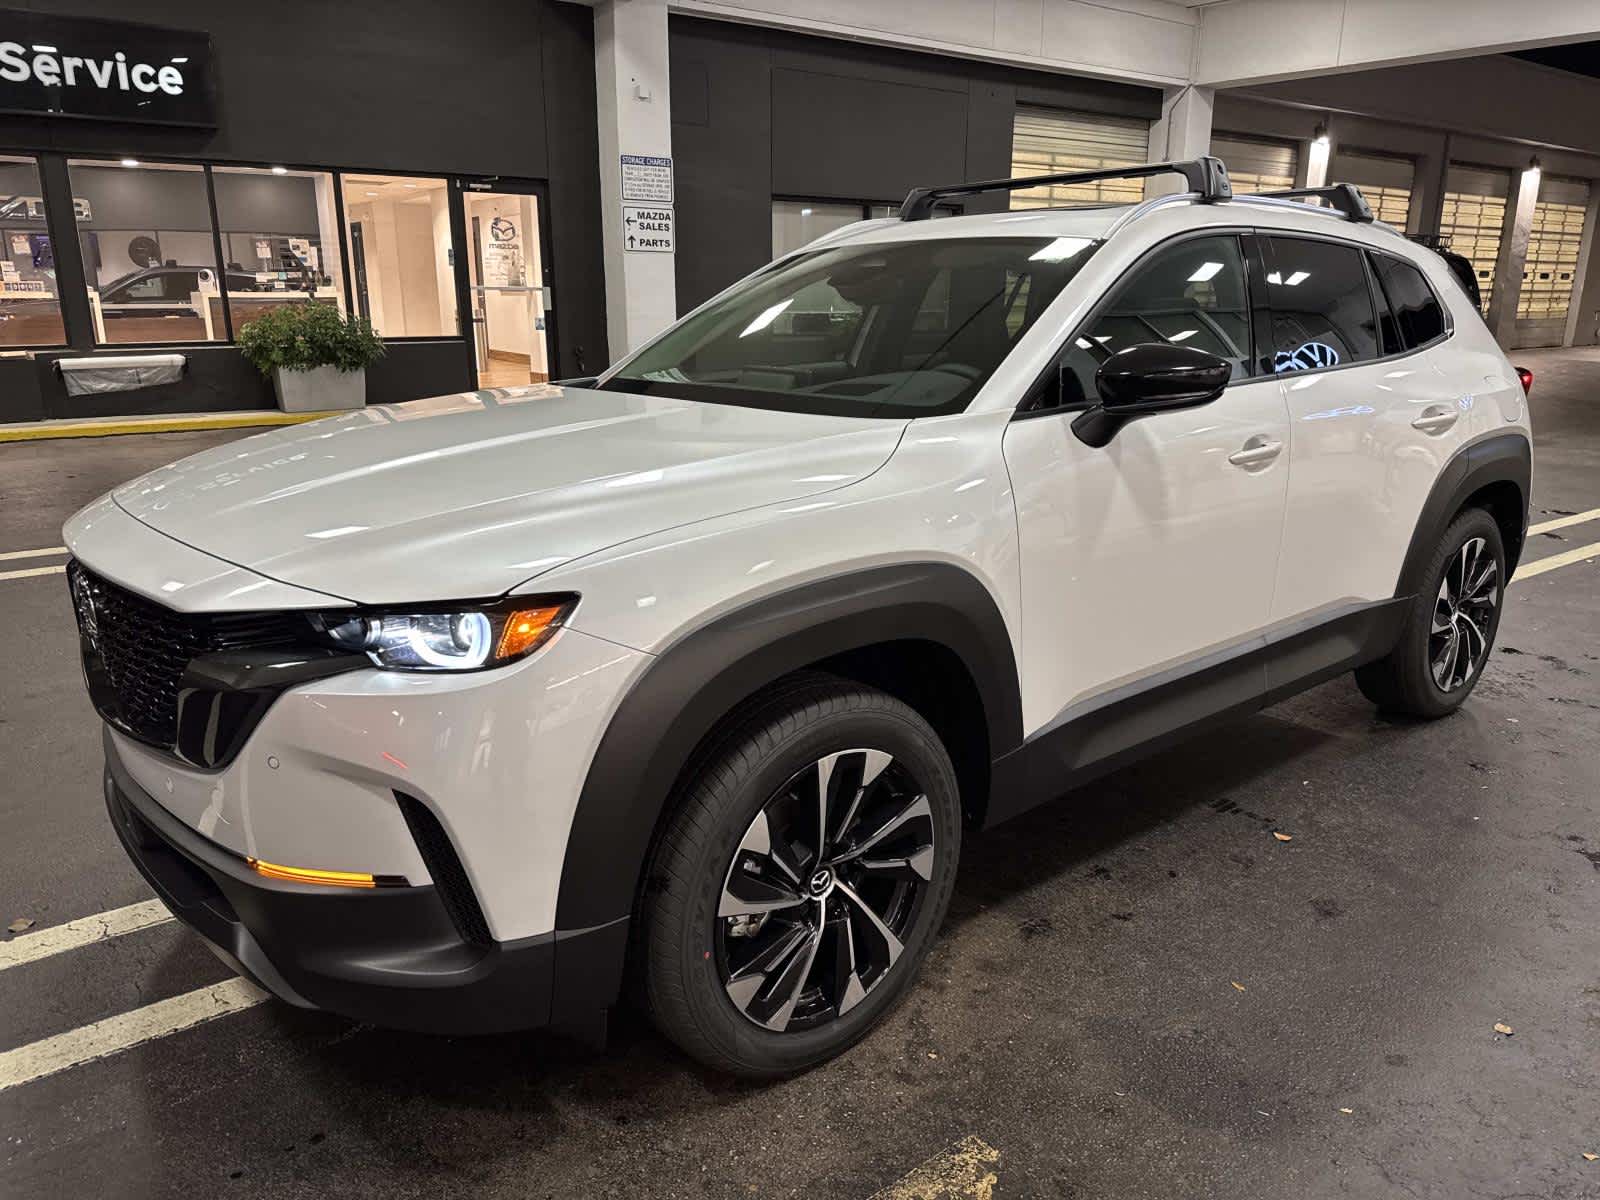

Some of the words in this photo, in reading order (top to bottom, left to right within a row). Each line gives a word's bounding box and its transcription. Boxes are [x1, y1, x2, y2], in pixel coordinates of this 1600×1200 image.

[0, 41, 184, 95] Service
[622, 156, 645, 165] STORAGE
[646, 158, 671, 167] CHARGES
[637, 211, 671, 221] MAZDA
[639, 222, 670, 232] SALES
[639, 238, 671, 248] PARTS
